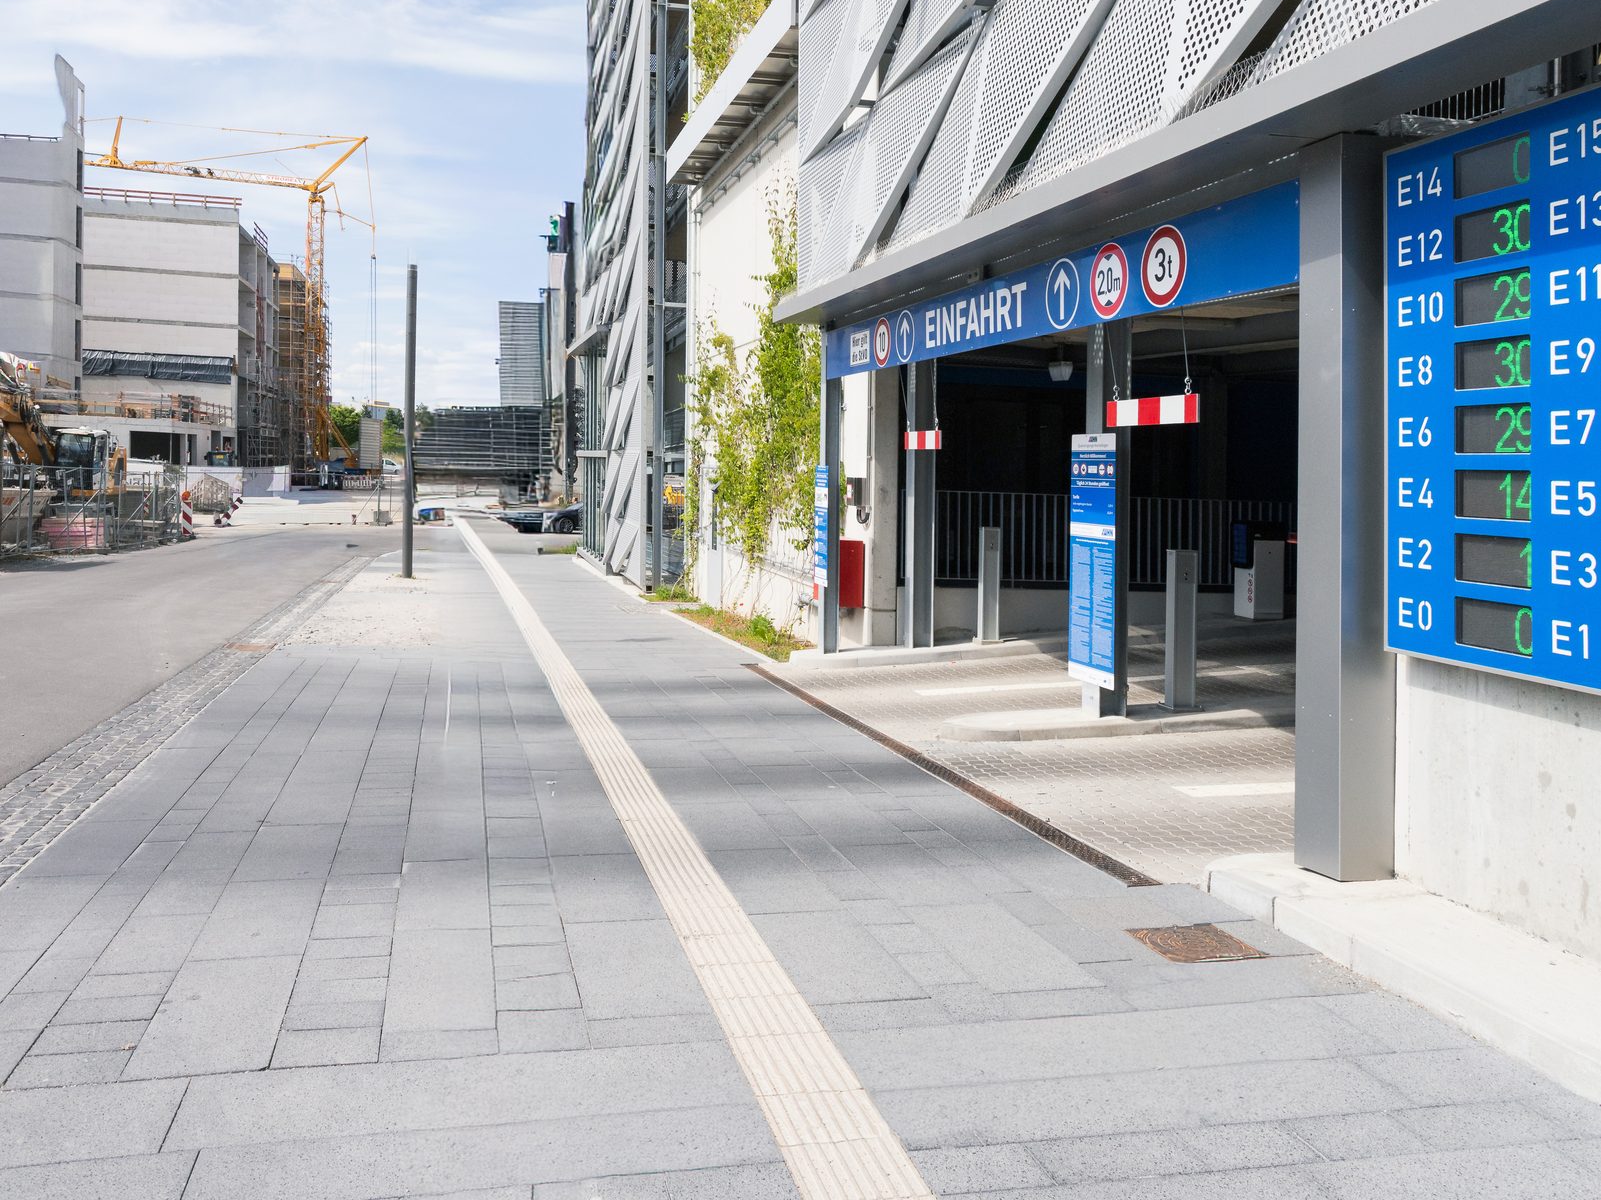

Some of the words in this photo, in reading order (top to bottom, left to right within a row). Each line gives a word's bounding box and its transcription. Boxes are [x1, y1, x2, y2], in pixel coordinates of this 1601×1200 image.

[1398, 166, 1442, 208] E14
[1398, 228, 1443, 268] E12
[1493, 204, 1531, 256] 30
[1494, 272, 1531, 321] 29
[1550, 263, 1601, 306] E11
[926, 281, 1027, 349] EINFAHRT
[1398, 291, 1444, 327] E10
[878, 332, 886, 354] 10
[1550, 337, 1596, 376] E9
[1398, 355, 1433, 388] E8
[1495, 340, 1531, 387] 30
[1398, 416, 1432, 447] E6
[1495, 406, 1531, 453] 29
[1550, 409, 1596, 445] E7
[1398, 477, 1434, 509] E4
[1499, 472, 1532, 522] 14
[1550, 480, 1597, 517] E5
[1398, 537, 1432, 571] E2
[1519, 540, 1532, 588] 1
[1551, 550, 1598, 589] E3
[1398, 596, 1432, 631] E0
[1551, 619, 1590, 660] E1
